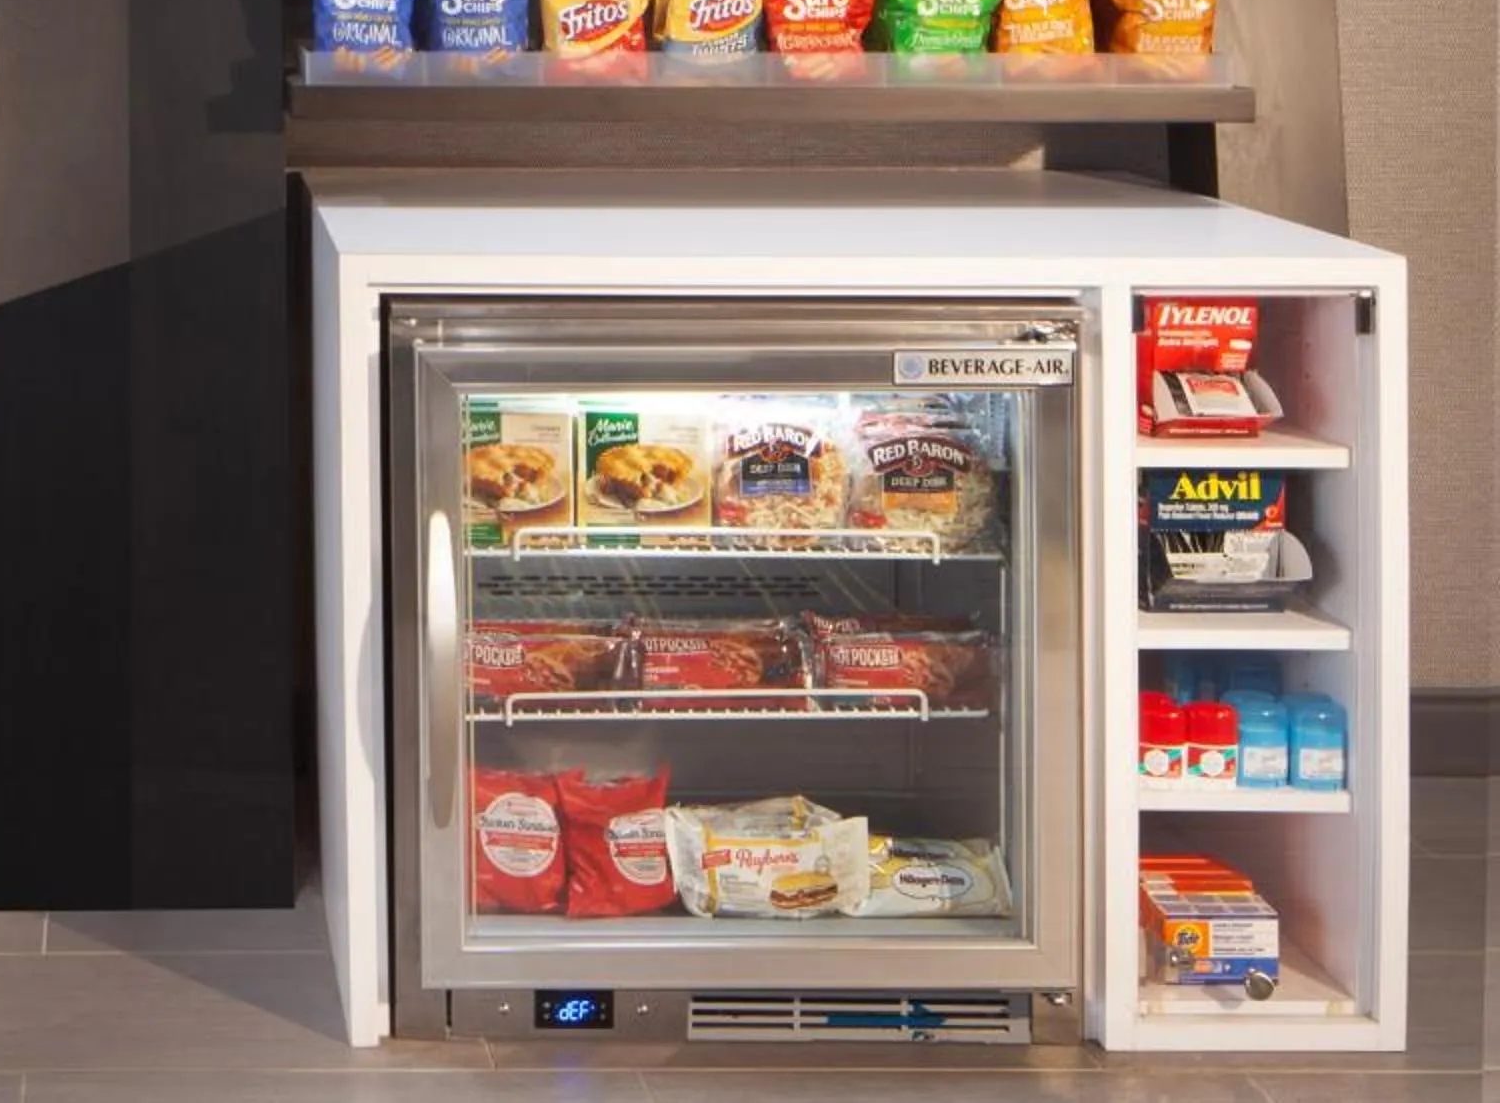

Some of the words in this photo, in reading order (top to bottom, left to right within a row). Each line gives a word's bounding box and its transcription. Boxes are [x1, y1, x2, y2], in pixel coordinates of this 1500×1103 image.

[1158, 304, 1253, 327] TYLENOL
[928, 359, 1066, 376] BEVERAGE-AIR
[734, 429, 762, 451] RED
[873, 446, 906, 466] RED
[906, 439, 964, 466] BARON
[1169, 471, 1262, 501] Advil
